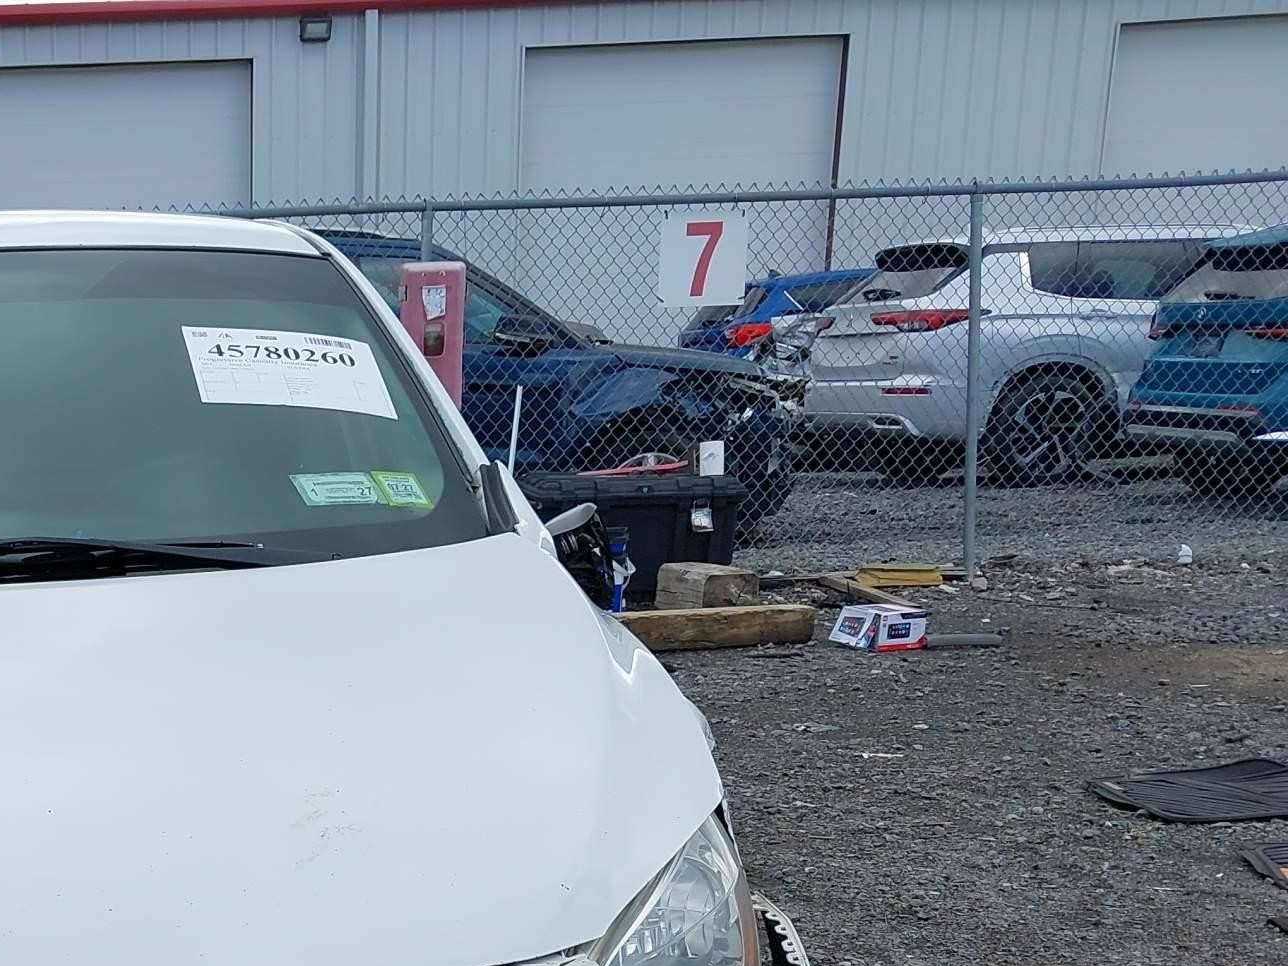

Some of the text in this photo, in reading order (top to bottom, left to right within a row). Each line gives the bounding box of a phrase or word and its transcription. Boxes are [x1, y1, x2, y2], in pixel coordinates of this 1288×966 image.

[686, 221, 723, 297] 7
[207, 343, 356, 368] 45780260
[357, 486, 372, 496] 27
